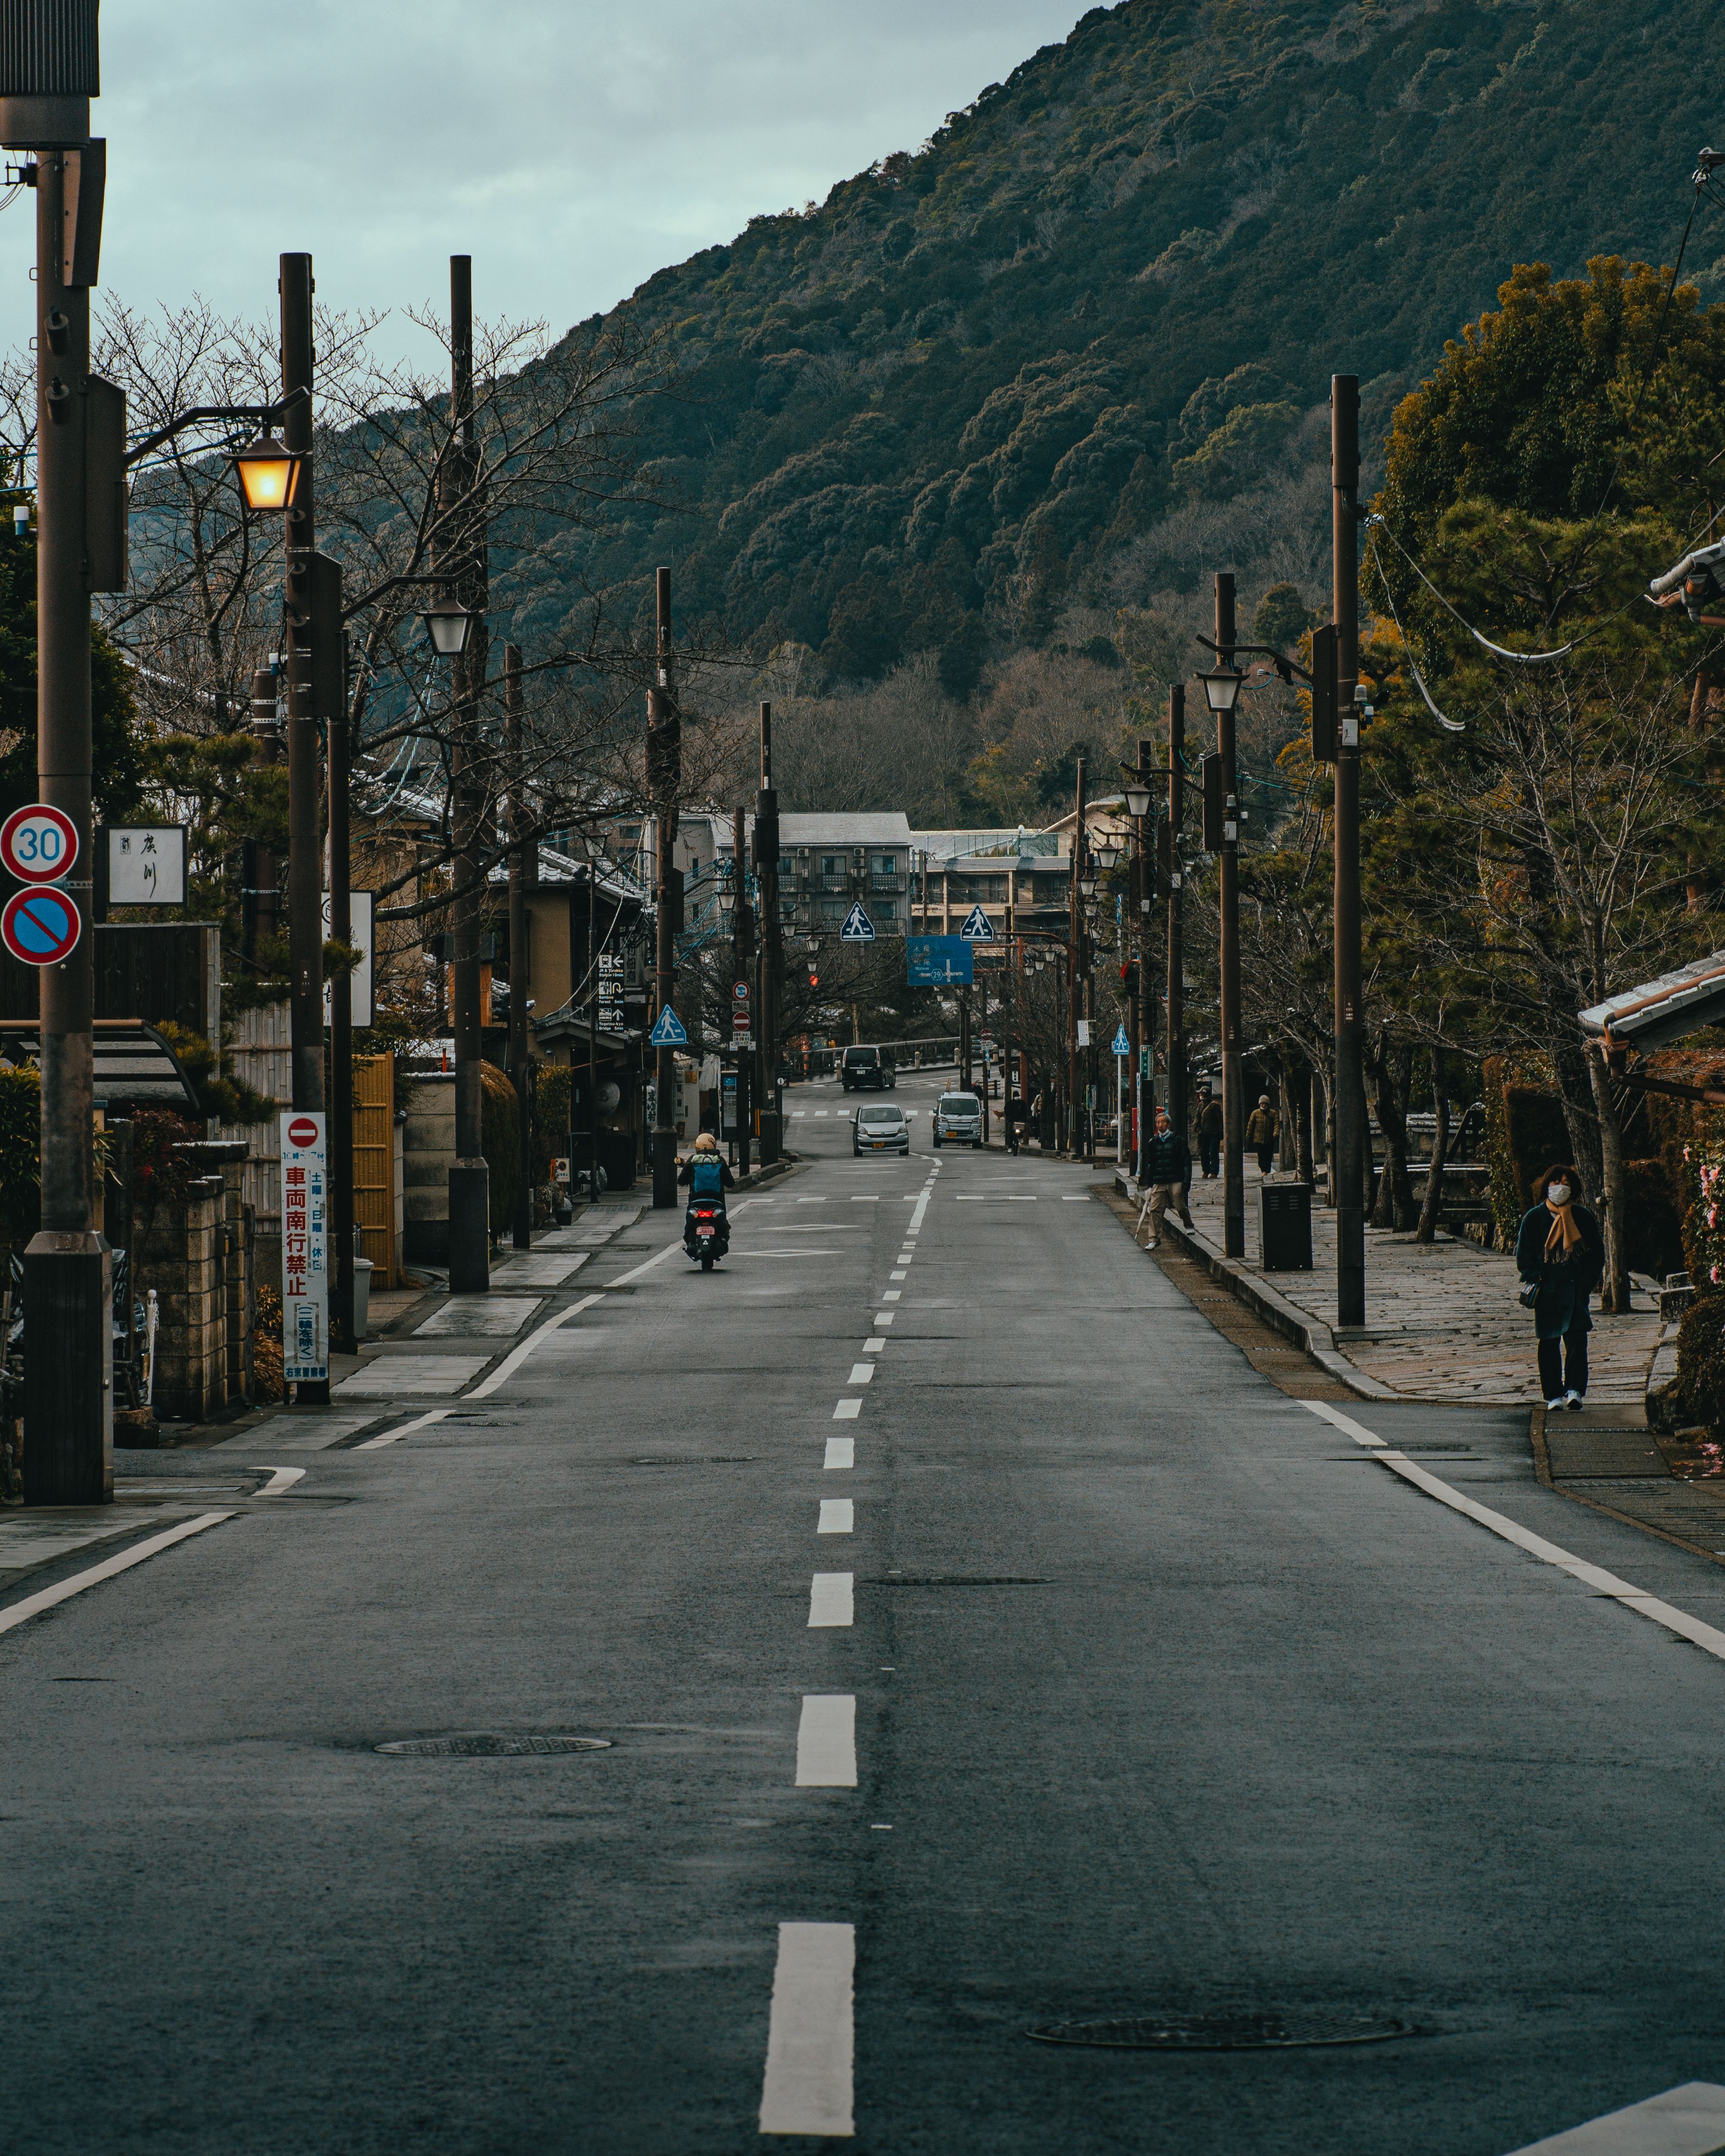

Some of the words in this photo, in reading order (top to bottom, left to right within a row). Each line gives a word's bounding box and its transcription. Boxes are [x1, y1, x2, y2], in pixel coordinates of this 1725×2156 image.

[19, 828, 60, 860] 30
[647, 1089, 656, 1122] まゆ村
[285, 1166, 307, 1296] 車両南行禁止
[286, 1367, 327, 1378] 右京警察署
